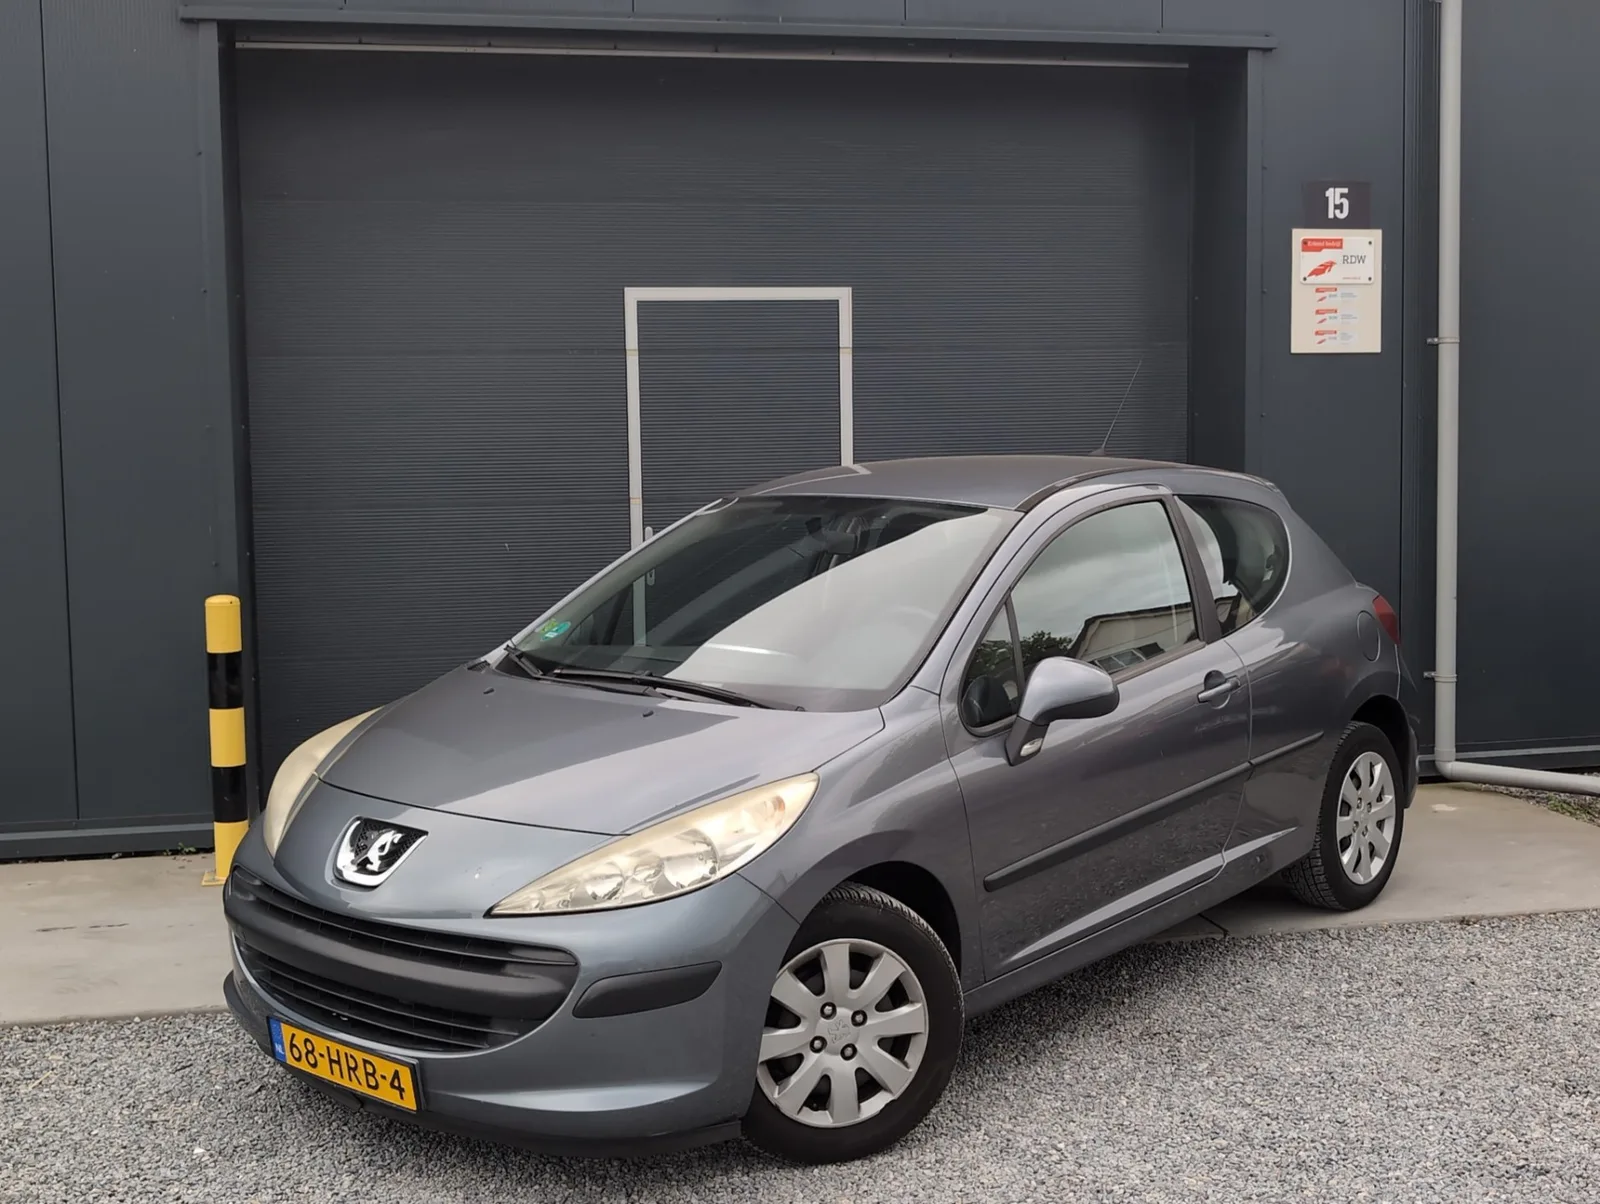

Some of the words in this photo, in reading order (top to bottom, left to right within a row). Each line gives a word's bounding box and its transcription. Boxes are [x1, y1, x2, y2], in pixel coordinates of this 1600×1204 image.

[1325, 187, 1349, 219] 15
[1342, 255, 1367, 265] RDW
[289, 1032, 405, 1101] 68-HRB-4
